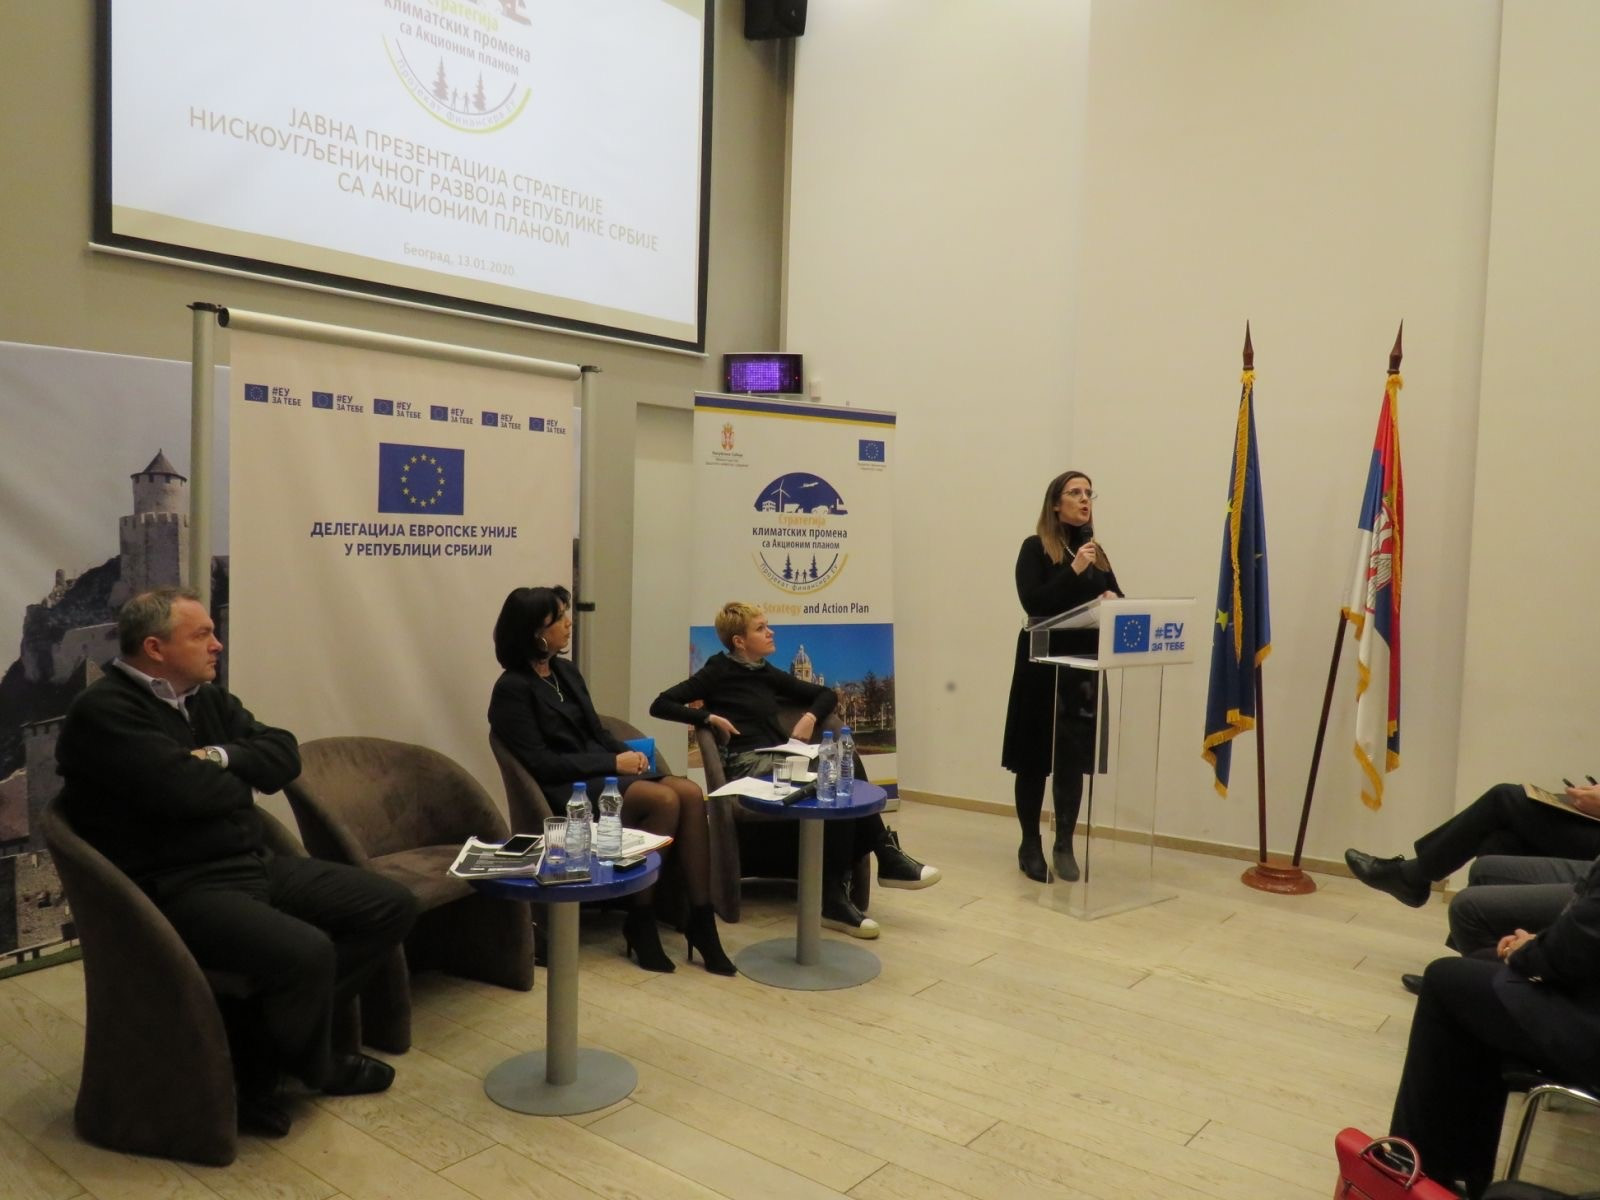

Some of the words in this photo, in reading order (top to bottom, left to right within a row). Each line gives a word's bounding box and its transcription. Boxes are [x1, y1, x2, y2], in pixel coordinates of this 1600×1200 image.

[400, 21, 412, 36] са
[416, 24, 475, 59] Акционим
[478, 52, 519, 76] планом
[474, 29, 531, 63] промена
[289, 108, 359, 146] ЈАВНА
[365, 130, 508, 188] ПРЕЗЕНТАЦИЈА
[514, 174, 604, 215] СТРАТЕГИЈЕ
[190, 106, 424, 187] НИСКОУГЉЕНИЧНОГ
[431, 172, 507, 210] РАЗВОЈА
[513, 196, 604, 237] РЕПУБЛИКЕ
[609, 223, 659, 251] СРБИЈЕ
[338, 172, 365, 197] СА
[372, 181, 488, 228] АКЦИОНИМ
[494, 212, 570, 248] ПЛАНОМ
[272, 387, 290, 397] #ЕУ
[272, 396, 283, 405] ЗА
[284, 397, 302, 407] ТЕБЕ
[336, 395, 353, 404] #ЕУ
[336, 403, 346, 411] ЗА
[778, 514, 827, 527] Стратегија
[310, 522, 405, 538] ДЕЛЕГАЦИЈА
[409, 524, 477, 538] ЕВРОПСКЕ
[481, 526, 518, 539] УНИЈЕ
[752, 527, 807, 537] климатских
[809, 529, 848, 540] промена
[344, 543, 353, 556] У
[357, 543, 441, 558] РЕПУБЛИЦИ
[444, 544, 492, 557] СРБИЈИ
[762, 541, 771, 549] са
[772, 539, 811, 550] Акционим
[812, 541, 840, 550] планом
[763, 602, 801, 616] Strategy
[803, 603, 820, 614] and
[822, 603, 849, 614] Action
[850, 603, 869, 614] Plan
[1155, 622, 1185, 639] #ЕУ
[1151, 642, 1164, 652] ЗА
[1165, 641, 1185, 651] ТЕБЕ
